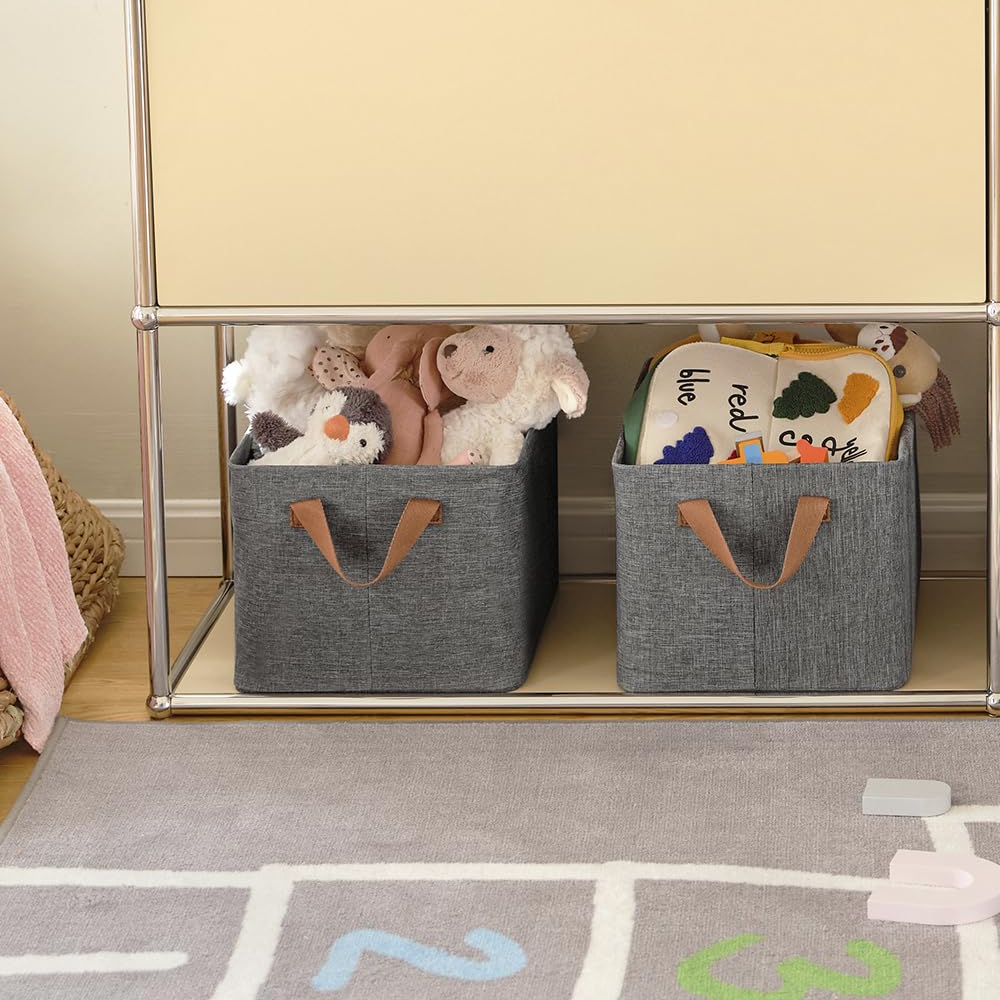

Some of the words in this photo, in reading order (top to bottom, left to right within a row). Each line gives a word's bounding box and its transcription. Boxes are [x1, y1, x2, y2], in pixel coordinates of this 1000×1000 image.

[676, 368, 711, 406] blue
[727, 383, 759, 433] red
[312, 929, 528, 990] 2
